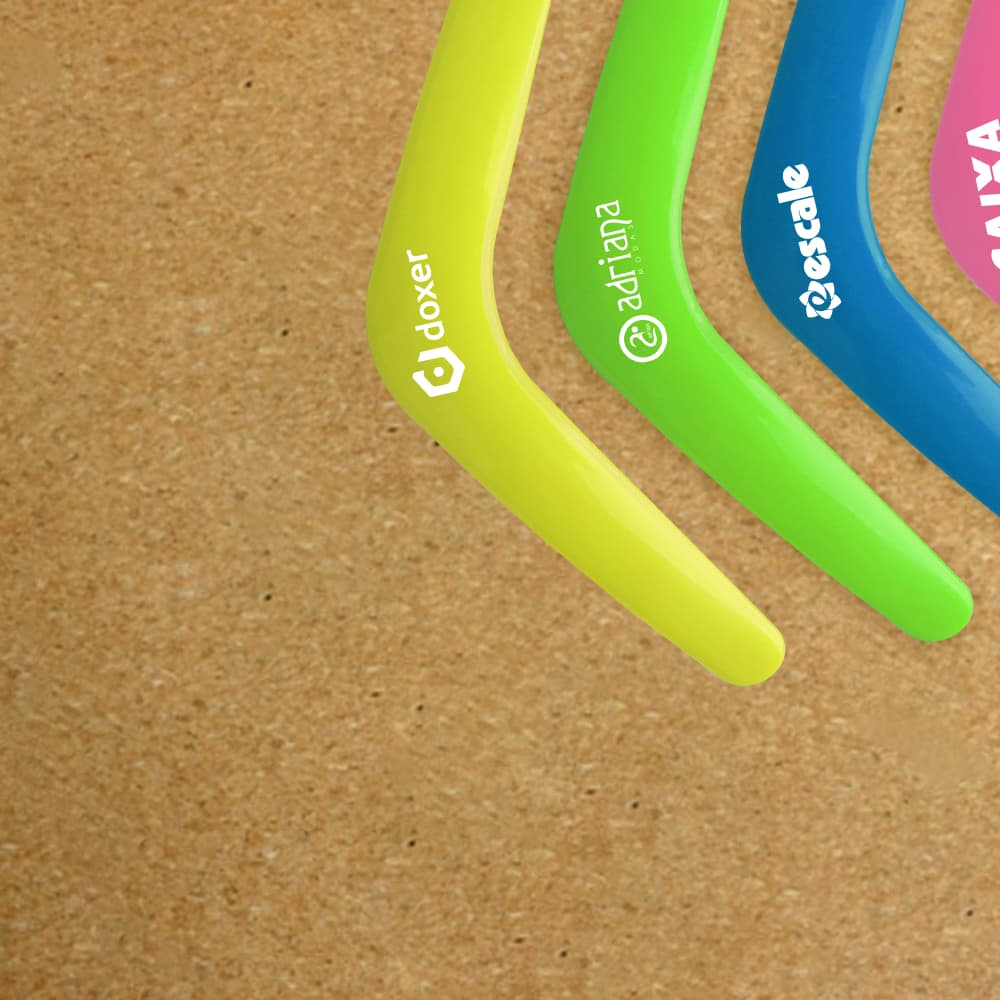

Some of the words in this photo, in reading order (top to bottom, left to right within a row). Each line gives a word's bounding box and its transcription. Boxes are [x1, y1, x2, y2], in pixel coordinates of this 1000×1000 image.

[595, 199, 643, 311] adriana
[627, 223, 645, 275] MODAS
[777, 163, 831, 280] escale
[406, 249, 445, 341] doxer
